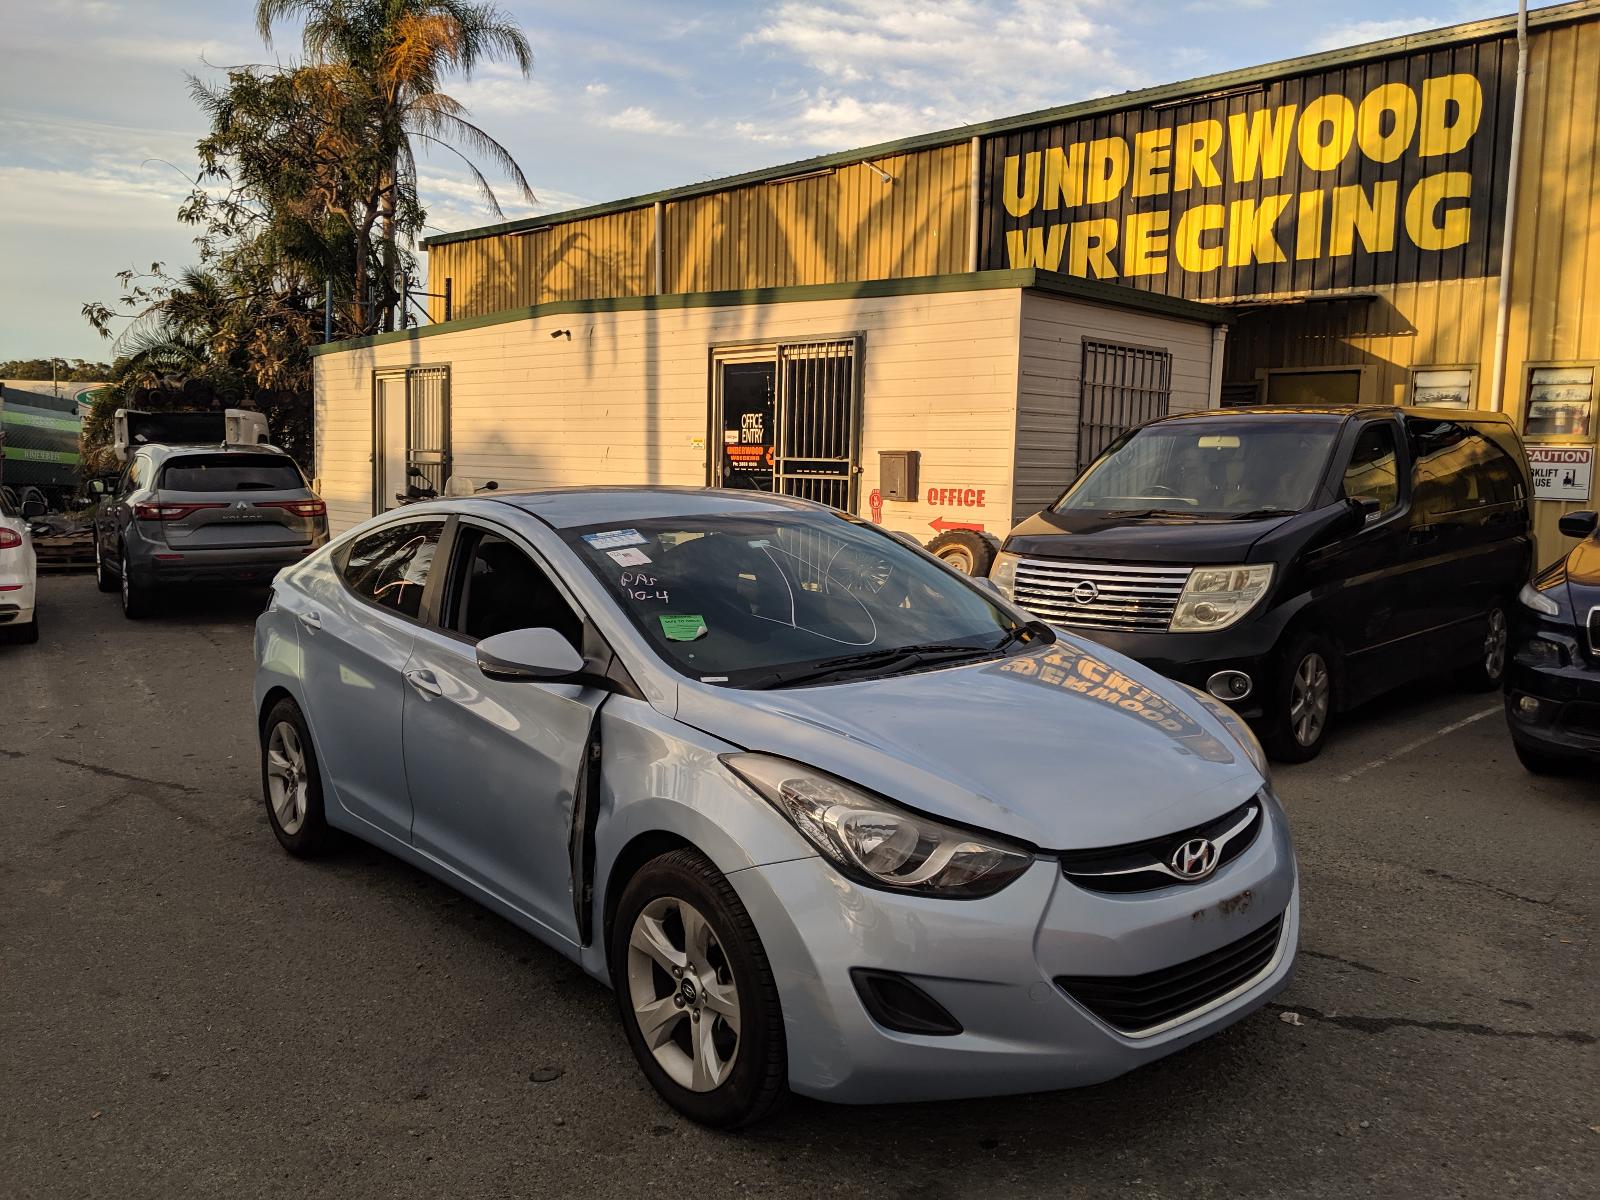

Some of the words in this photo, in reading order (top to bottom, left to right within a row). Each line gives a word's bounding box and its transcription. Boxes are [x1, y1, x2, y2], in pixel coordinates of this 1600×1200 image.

[1002, 73, 1483, 218] UNDERWOOD
[1006, 172, 1472, 279] WRECKING
[741, 413, 763, 429] OFFICE
[741, 428, 764, 444] ENTRY
[1530, 468, 1559, 478] RKLIFT
[1535, 479, 1552, 488] USE
[927, 487, 986, 508] OFFICE
